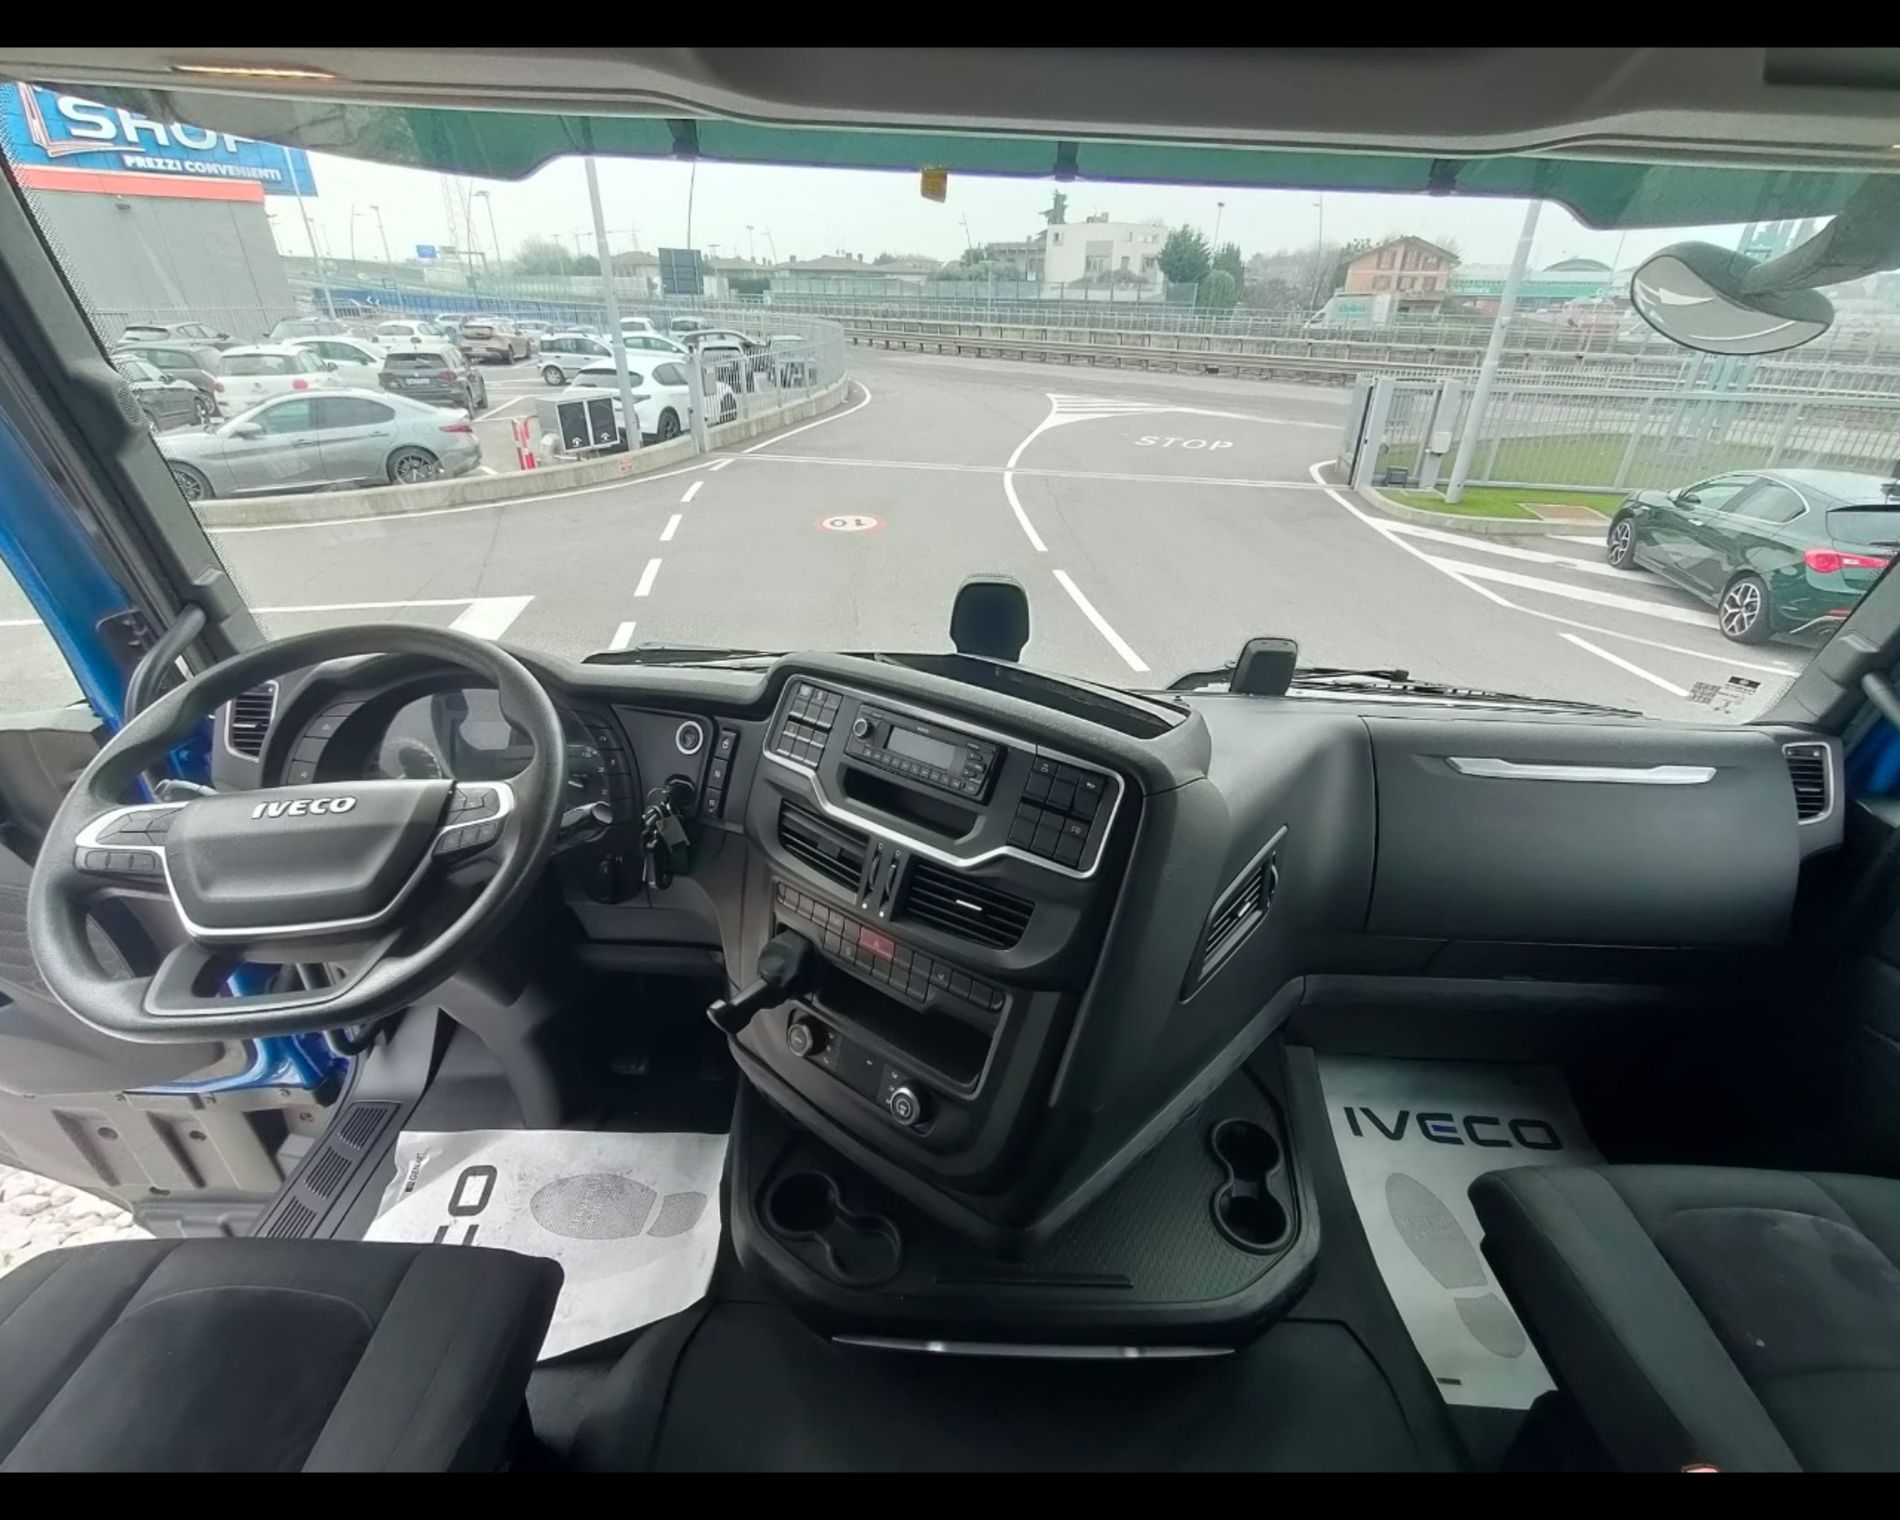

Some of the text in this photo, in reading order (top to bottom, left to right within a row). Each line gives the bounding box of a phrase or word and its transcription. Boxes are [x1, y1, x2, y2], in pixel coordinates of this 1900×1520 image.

[123, 154, 283, 182] PREZZI CONVENIENTI
[1134, 435, 1234, 450] STOP
[251, 796, 358, 820] IVECO
[1343, 1106, 1563, 1151] IVECO
